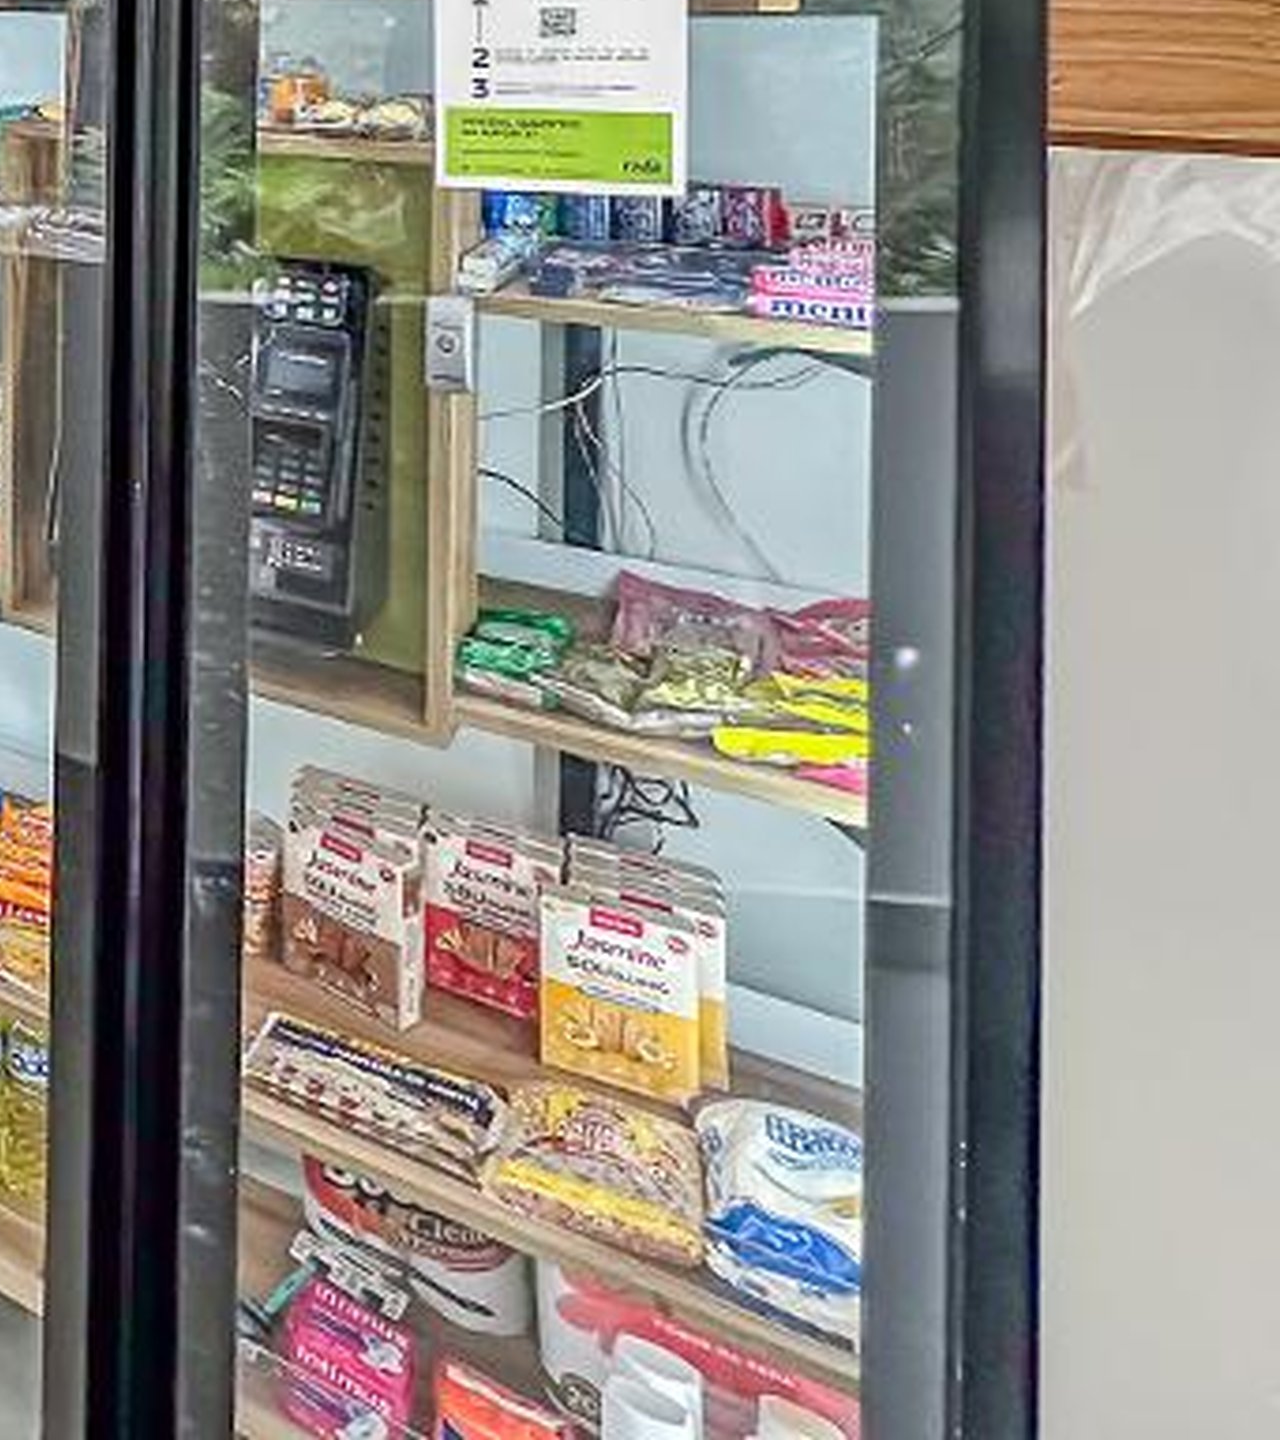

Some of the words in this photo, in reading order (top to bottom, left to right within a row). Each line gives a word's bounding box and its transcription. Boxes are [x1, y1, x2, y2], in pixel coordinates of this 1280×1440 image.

[471, 47, 490, 69] 2
[471, 77, 490, 99] 3
[566, 928, 668, 973] Jasmine
